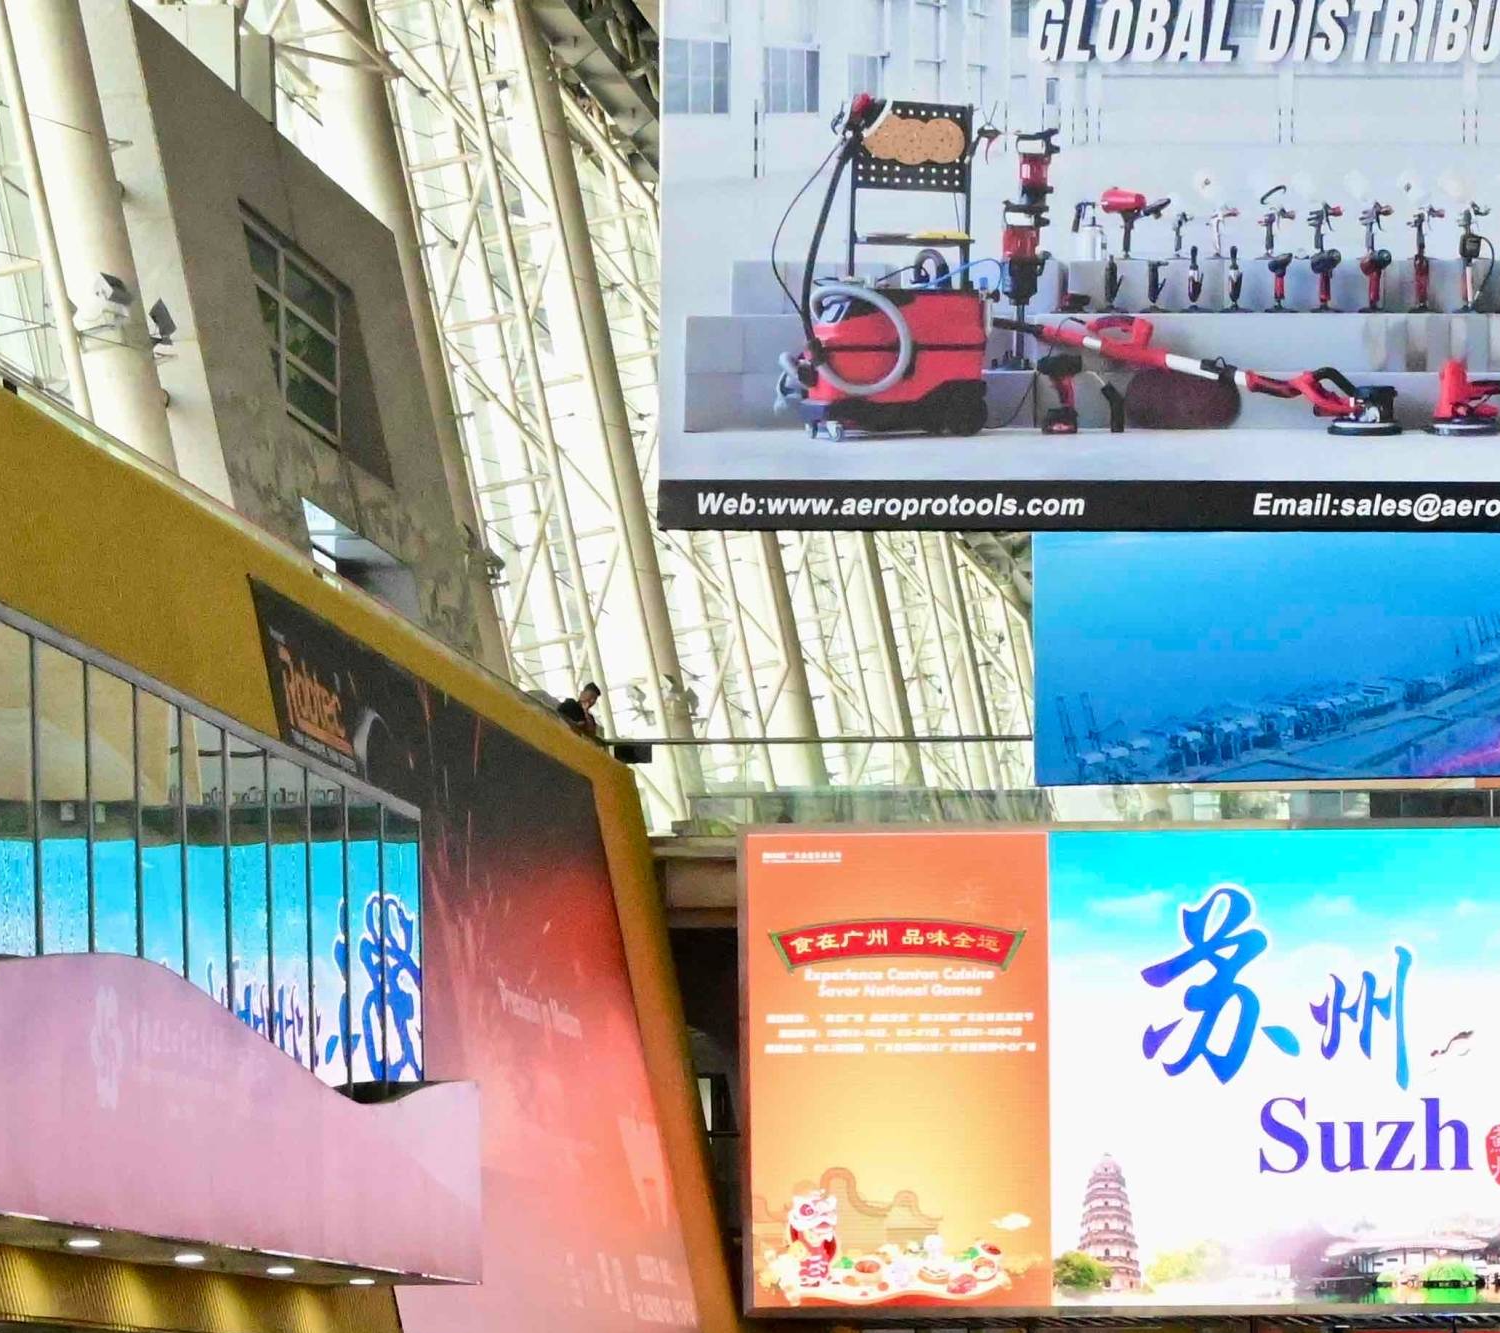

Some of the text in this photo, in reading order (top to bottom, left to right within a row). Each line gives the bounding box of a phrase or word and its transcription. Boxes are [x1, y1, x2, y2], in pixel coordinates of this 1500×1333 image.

[1030, 0, 1236, 63] GLOBAL
[697, 491, 1085, 520] Web:www.aeroprotools.com
[789, 928, 889, 955] 食在广州
[804, 967, 995, 984] Experience Canton Cuisine
[1140, 887, 1413, 1092] 苏州
[864, 984, 928, 998] National
[930, 983, 983, 997] Games
